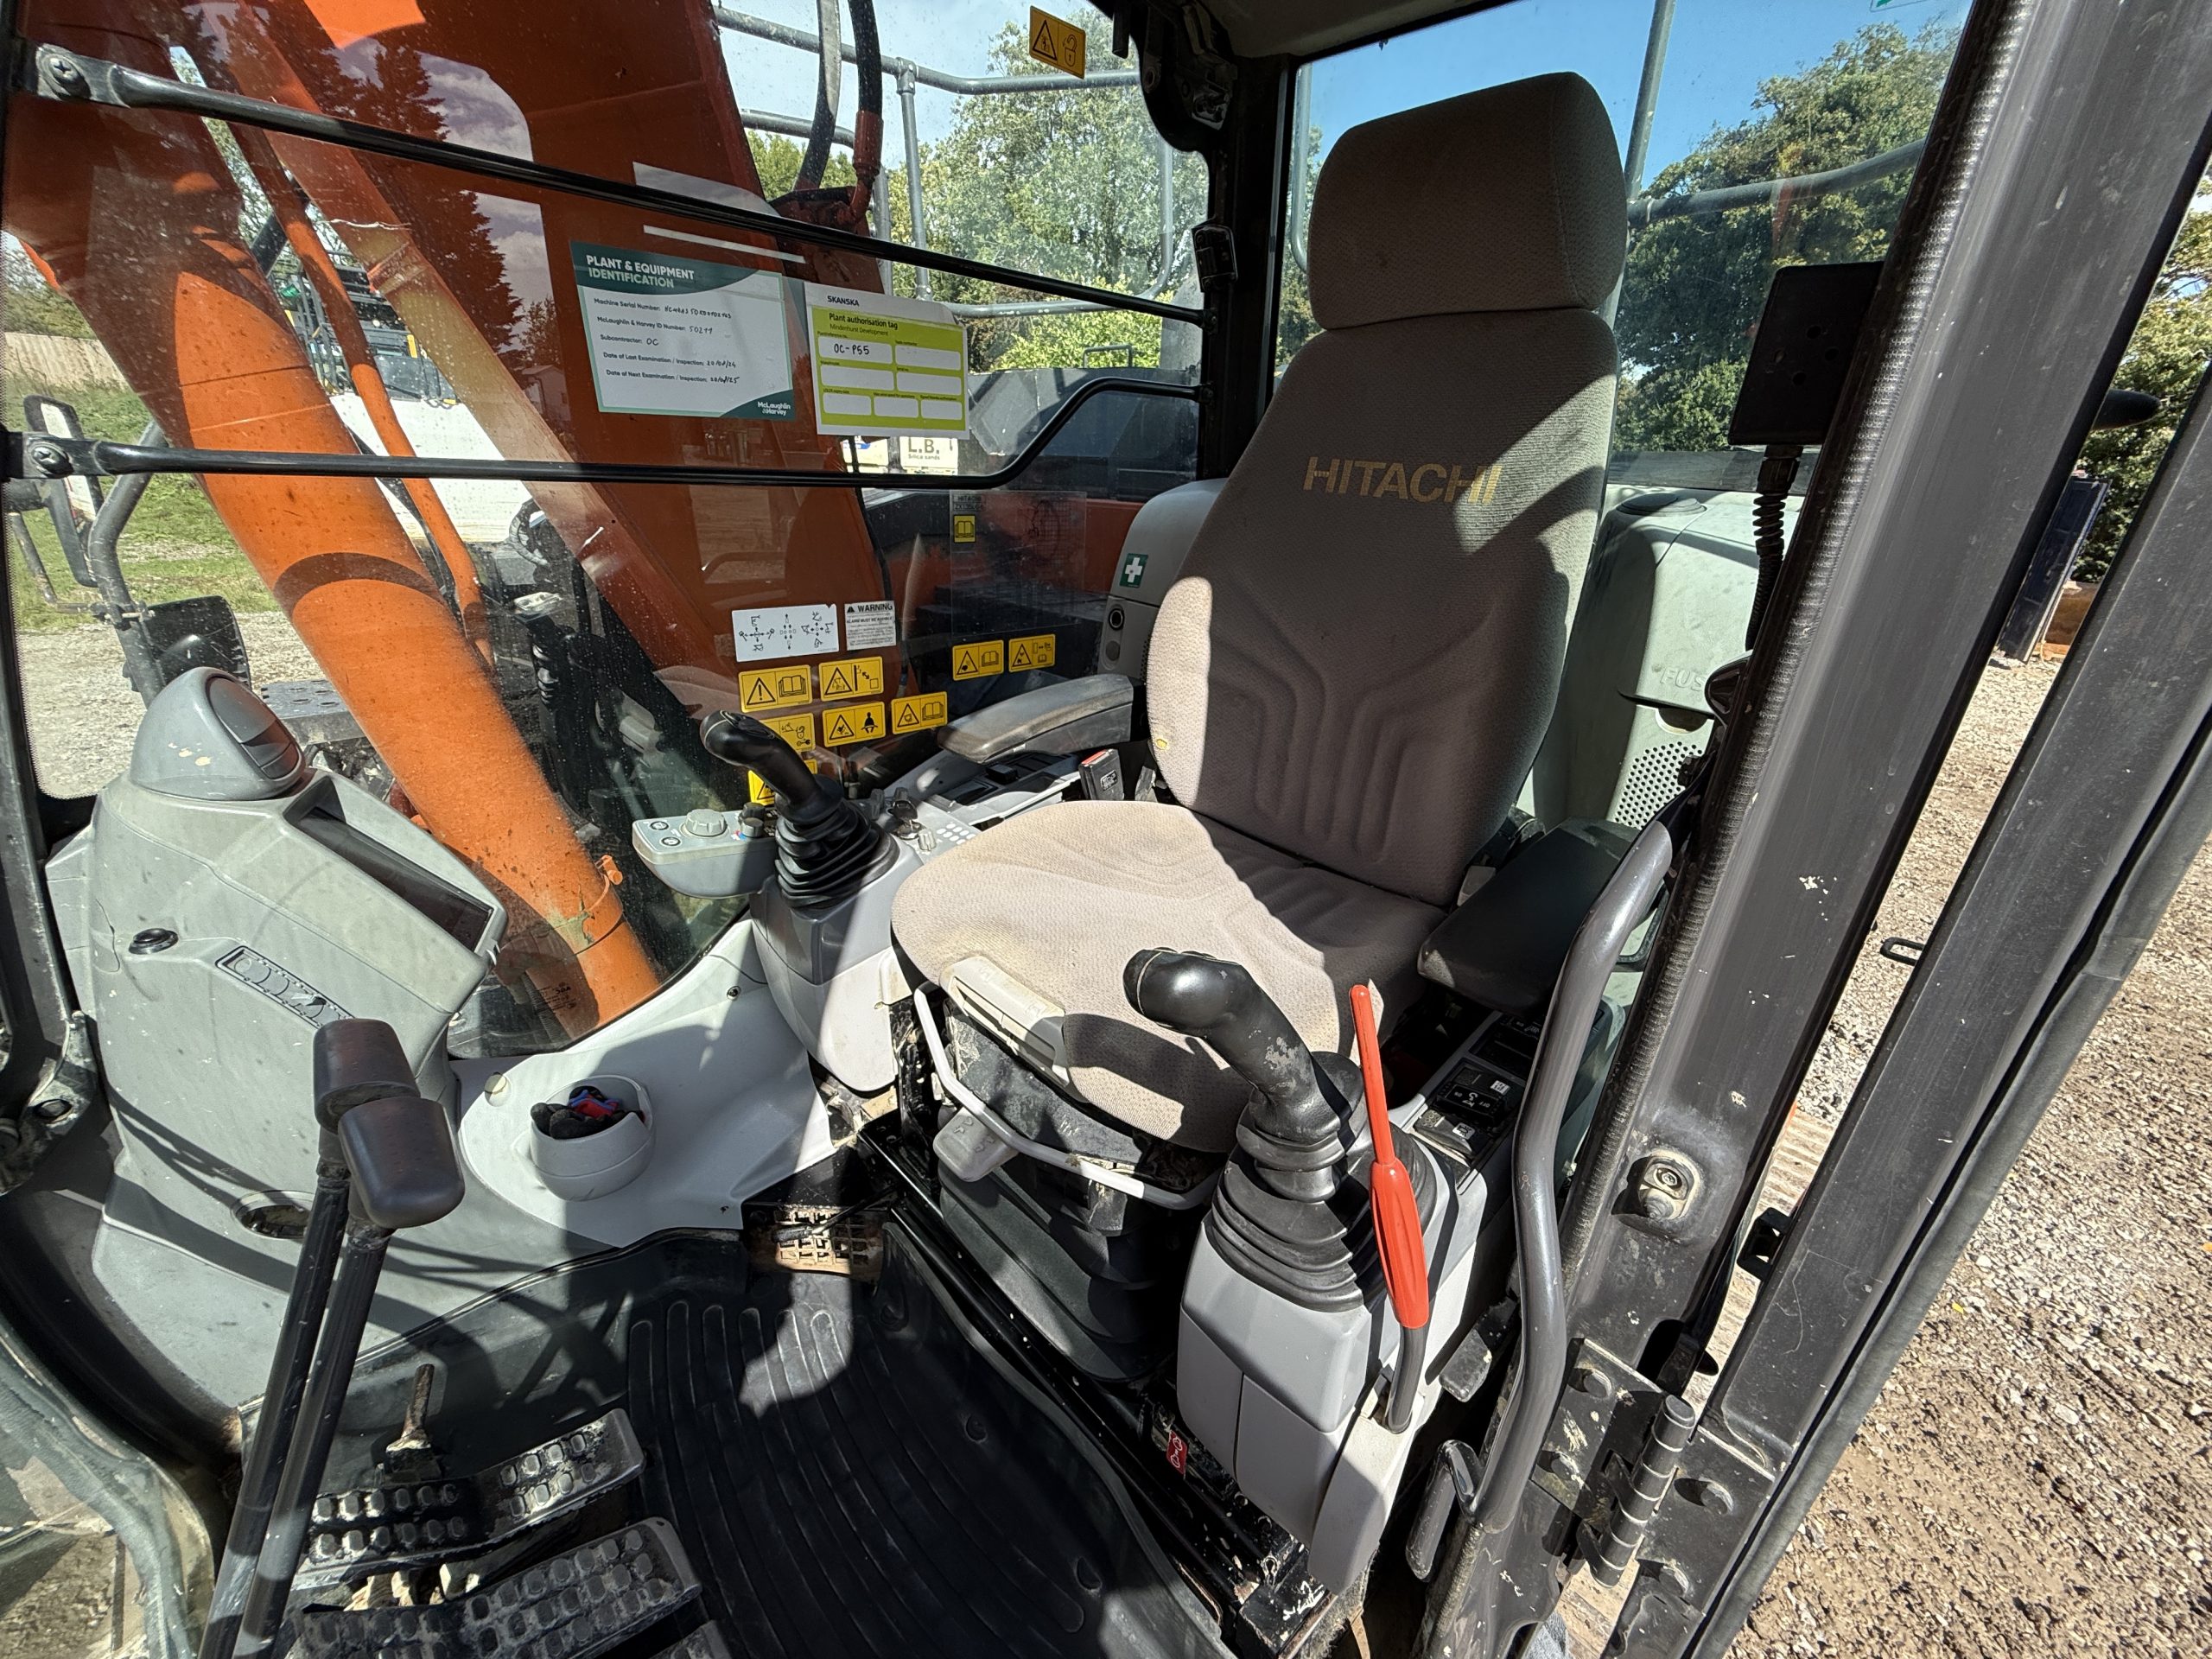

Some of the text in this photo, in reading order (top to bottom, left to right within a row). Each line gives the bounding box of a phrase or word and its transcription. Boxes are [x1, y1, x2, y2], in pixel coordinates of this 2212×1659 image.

[586, 255, 695, 280] PLANT & EQUIPMENT
[588, 267, 674, 288] IDENTIFICATION
[594, 298, 619, 307] Machine
[637, 303, 660, 312] Number:
[827, 296, 860, 307] SKANSKA
[597, 316, 630, 326] McLaughlin
[636, 321, 655, 329] Harvey
[829, 313, 898, 330] Plant authorisation tag
[830, 323, 888, 336] Mindenhurst Development
[600, 334, 643, 344] Subcontractor:
[646, 338, 659, 346] OC
[638, 355, 671, 364] Examination
[676, 358, 704, 366] Inspection:
[757, 401, 791, 410] McLaughlin
[1303, 456, 1503, 505] HITACHI
[857, 603, 893, 613] WARNING
